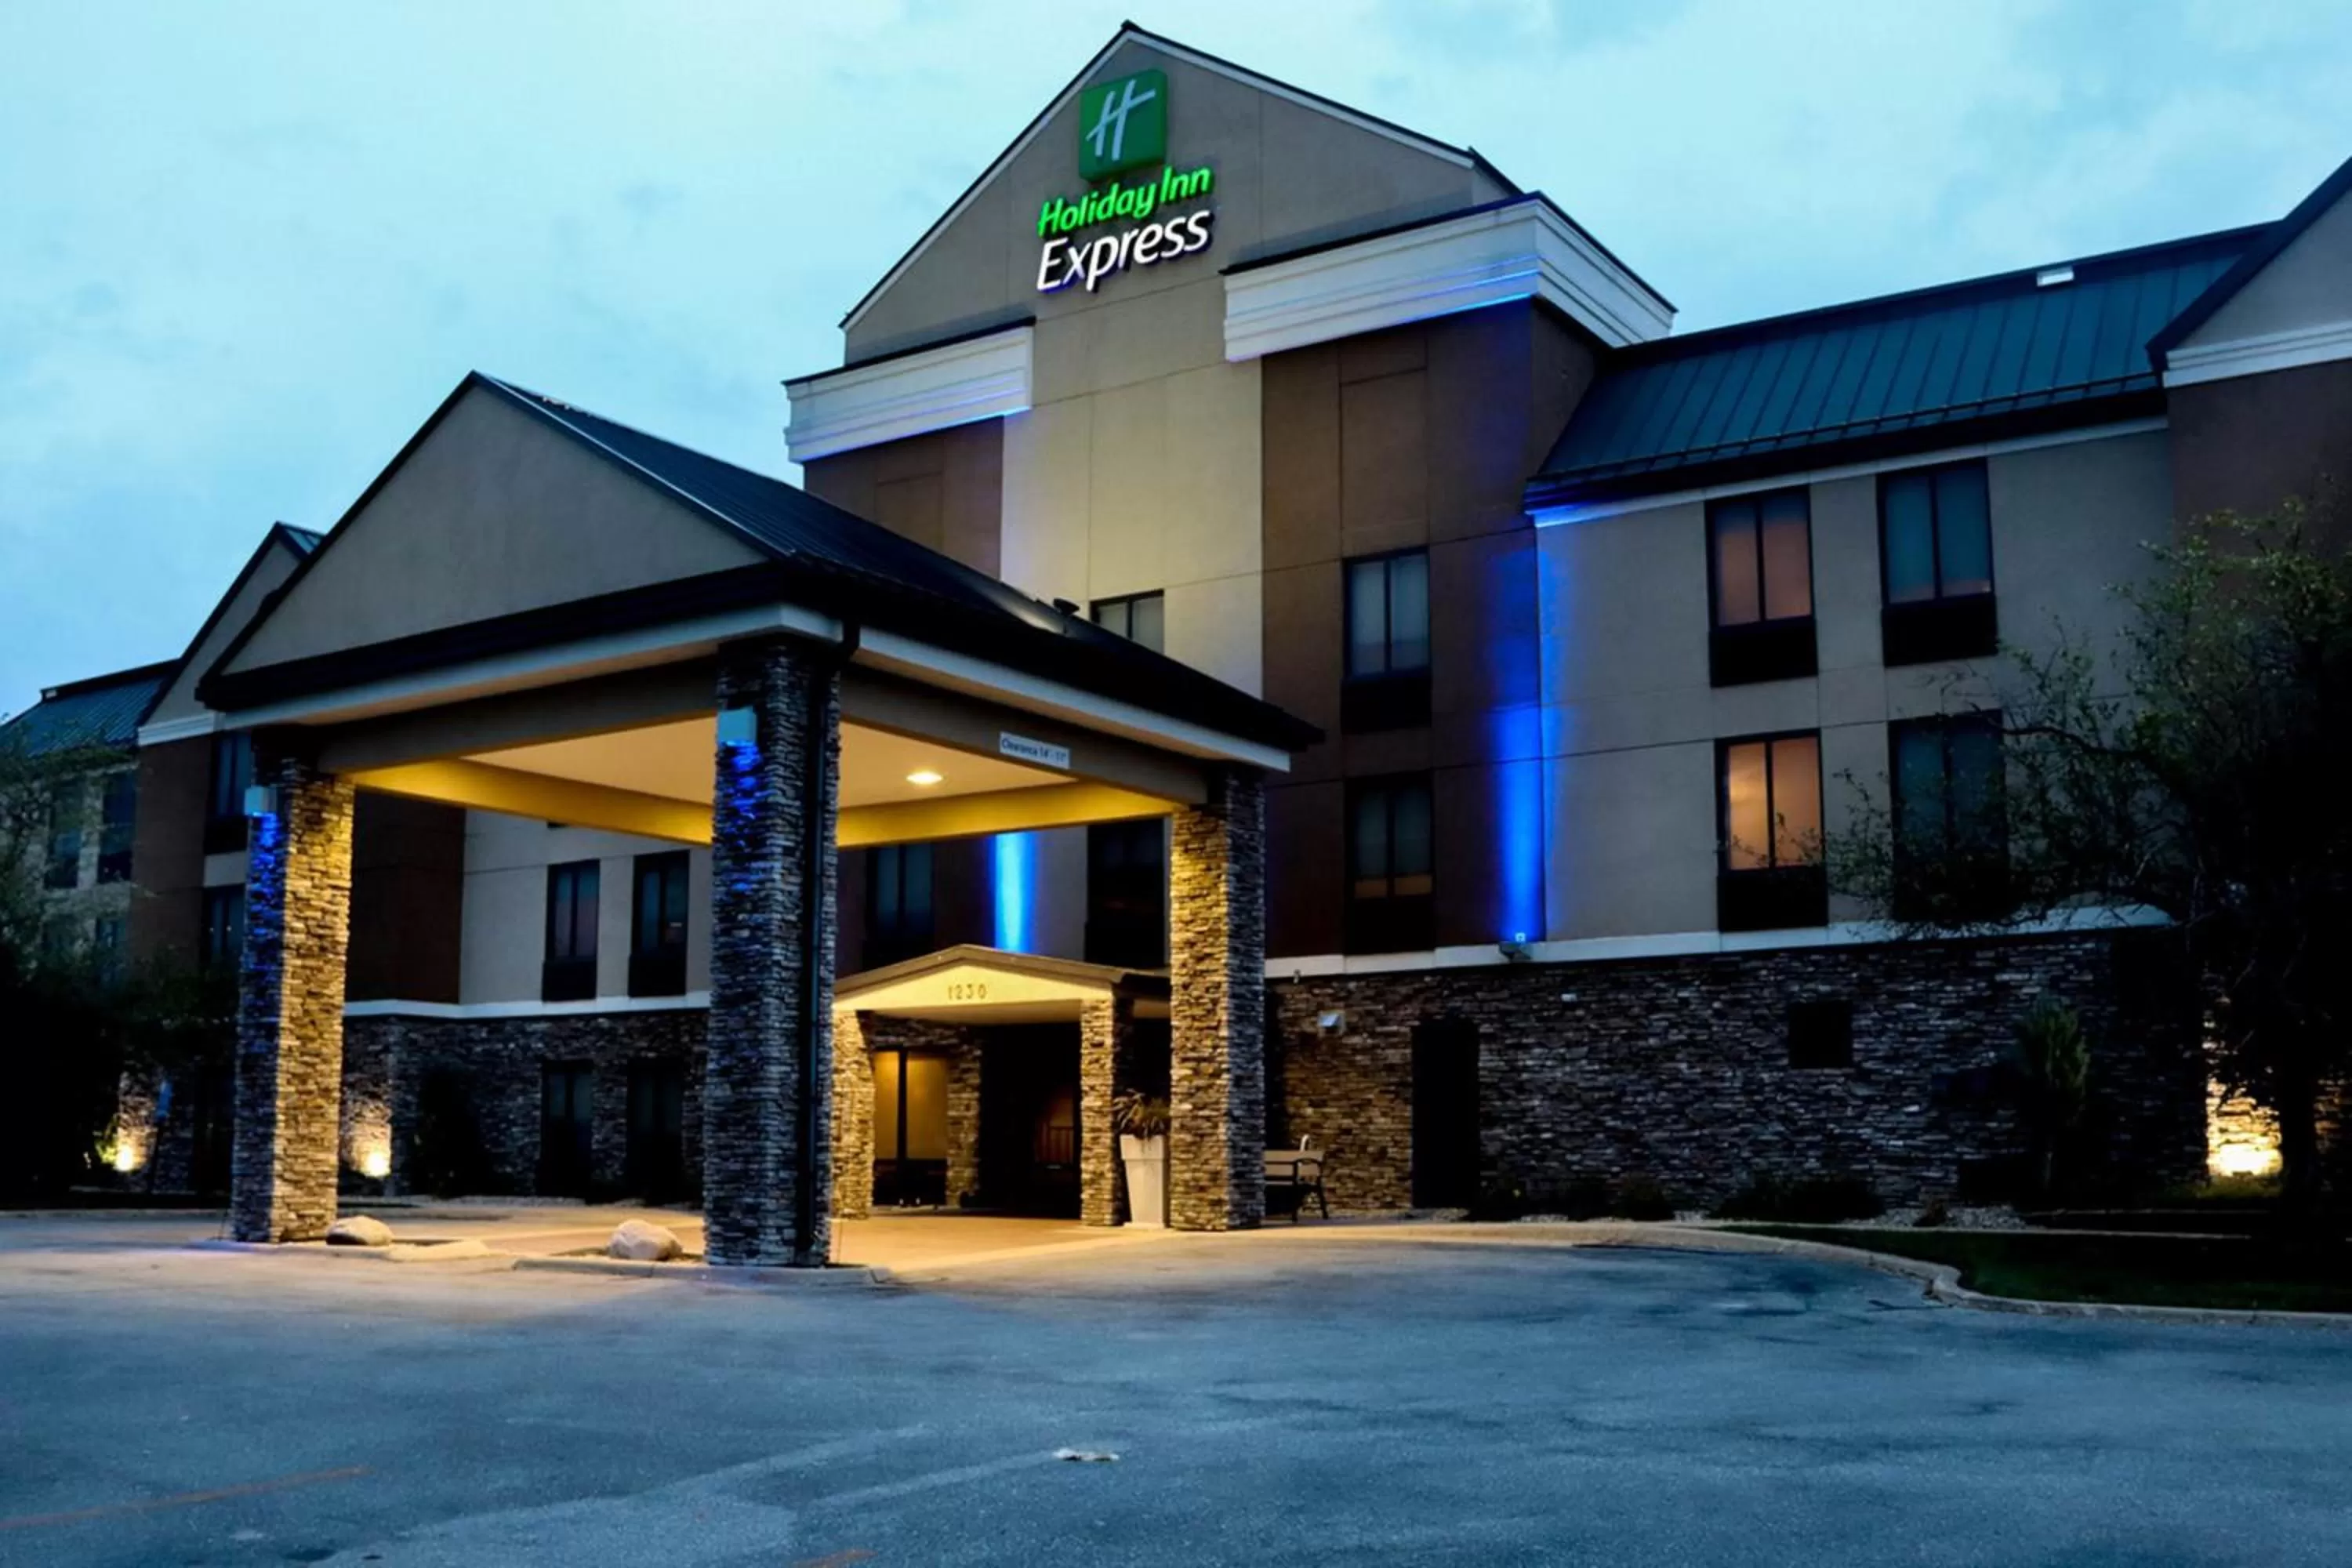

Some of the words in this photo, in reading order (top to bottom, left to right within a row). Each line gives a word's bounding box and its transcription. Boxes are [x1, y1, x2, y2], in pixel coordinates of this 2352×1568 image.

[1037, 183, 1156, 238] Holiday
[1160, 165, 1211, 204] Inn
[1036, 210, 1211, 292] Express
[947, 983, 987, 1000] 1230
